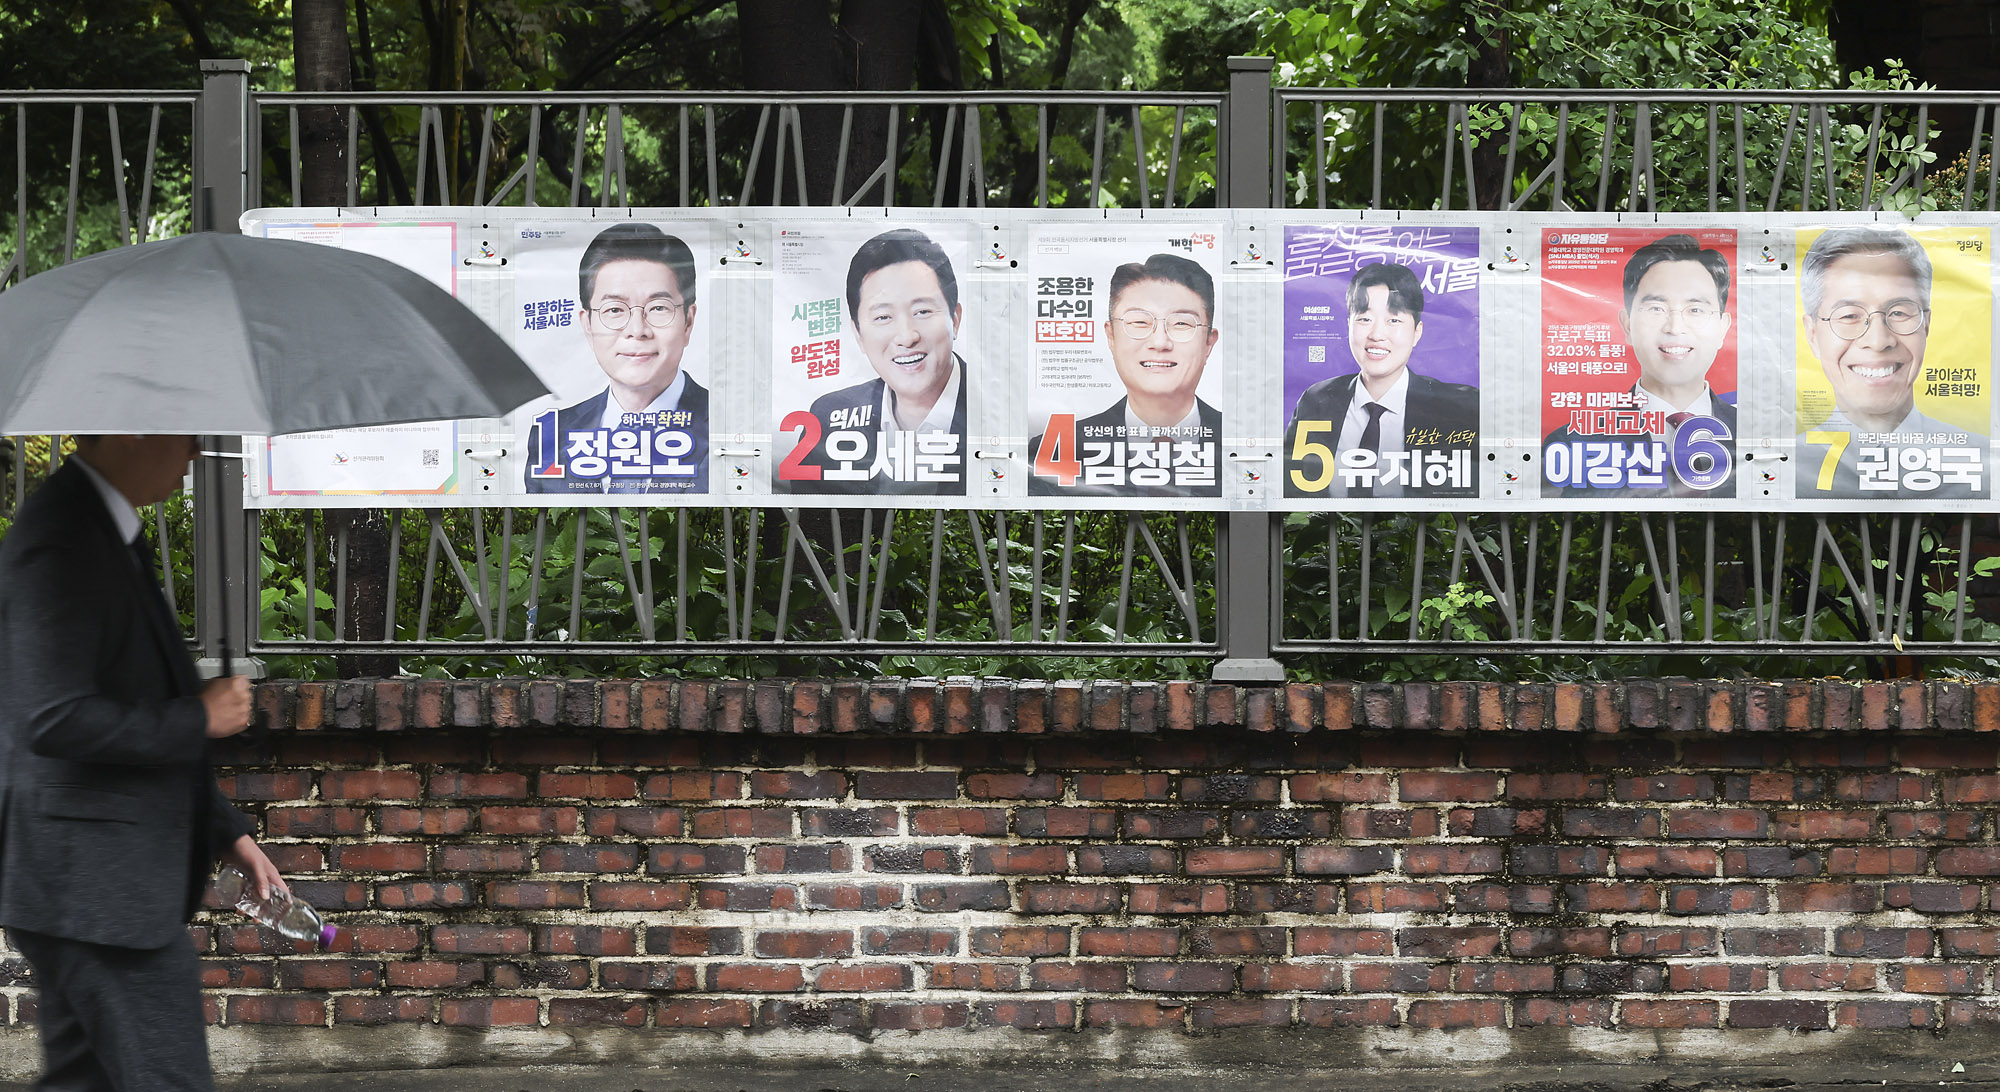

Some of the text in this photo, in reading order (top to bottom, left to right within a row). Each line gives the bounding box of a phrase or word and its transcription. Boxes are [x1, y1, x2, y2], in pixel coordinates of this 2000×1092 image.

[521, 231, 542, 239] 민주당
[1168, 232, 1215, 252] 개혁신당
[1560, 233, 1609, 244] 자유통일당
[1956, 240, 1984, 251] 정의당
[1421, 257, 1480, 295] 서울
[1037, 277, 1094, 296] 조용한
[791, 298, 841, 321] 시작된
[1037, 300, 1093, 318] 다수의
[1303, 306, 1330, 314] 여성의당
[523, 312, 572, 331] 서울시장
[808, 316, 842, 337] 변화
[1037, 321, 1093, 341] 변호인
[1547, 331, 1611, 343] 구로구 득표!
[791, 339, 840, 363] 압도적
[1547, 345, 1626, 357] 32.03% 돌풍!
[807, 358, 840, 379] 완성
[1547, 362, 1628, 375] 서울의 태풍으로!
[1925, 368, 1976, 381] 같이살자
[1550, 392, 1649, 408] 강한 미래보수
[1925, 384, 1980, 397] 서울혁명!
[622, 411, 692, 427] 하나씩 착착!
[829, 404, 873, 429] 역시!
[1567, 410, 1665, 436] 세대교체
[1083, 426, 1214, 437] 당신의 한 표를 끝까지 지키는
[1405, 427, 1476, 447] 유일한 선택
[1857, 433, 1968, 445] 뿌리부터 바꿀 서울시장
[531, 408, 565, 478] 1
[779, 410, 822, 481] 2
[1034, 412, 1082, 486] 4
[1671, 415, 1733, 490] 6
[566, 430, 695, 477] 정원오
[823, 430, 961, 482] 오세훈
[1083, 441, 1216, 486] 김정철
[1289, 420, 1335, 492] 5
[1545, 442, 1667, 484] 이강산
[1805, 431, 1851, 491] 7
[1338, 448, 1471, 488] 유지혜
[1856, 447, 1984, 492] 권영국
